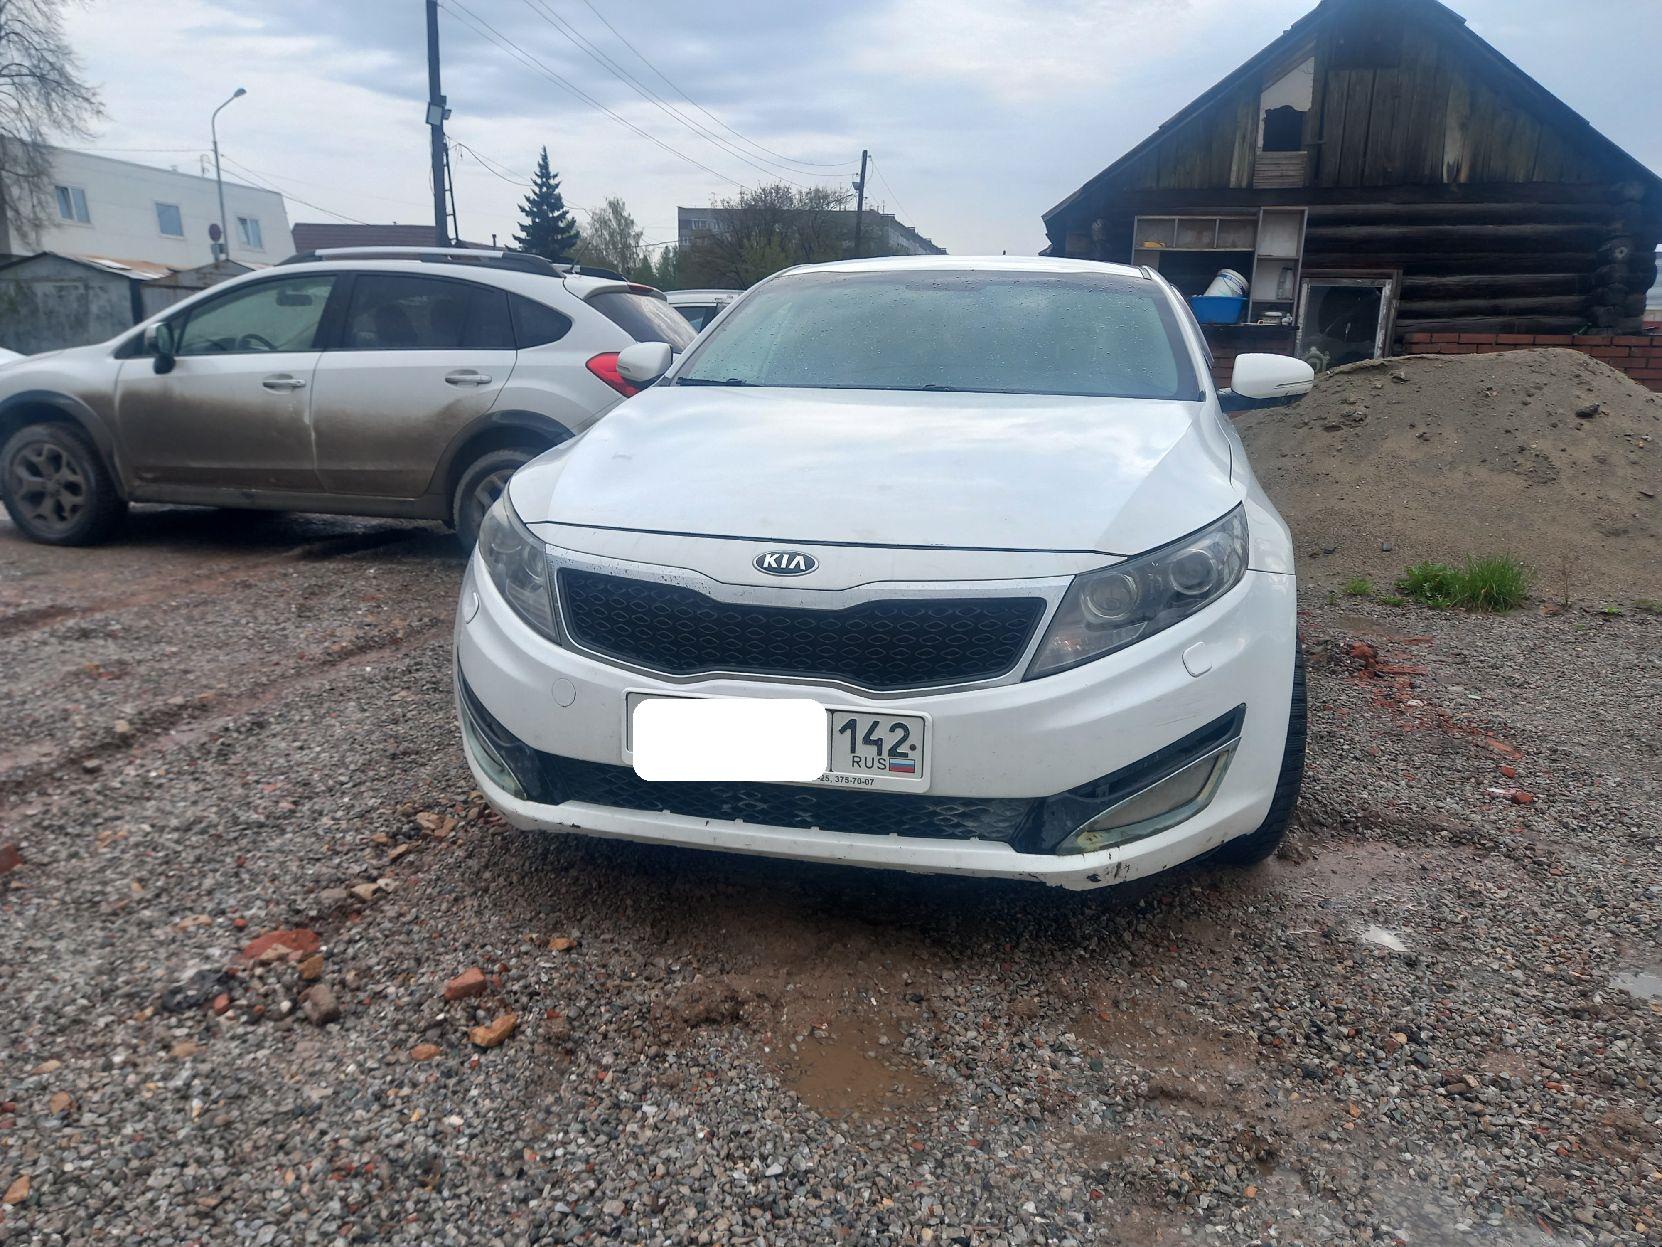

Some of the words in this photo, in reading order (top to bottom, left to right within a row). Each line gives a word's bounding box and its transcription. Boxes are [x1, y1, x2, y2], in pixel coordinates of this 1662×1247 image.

[762, 553, 806, 570] KIA
[838, 718, 911, 758] 142
[851, 755, 887, 770] RUS
